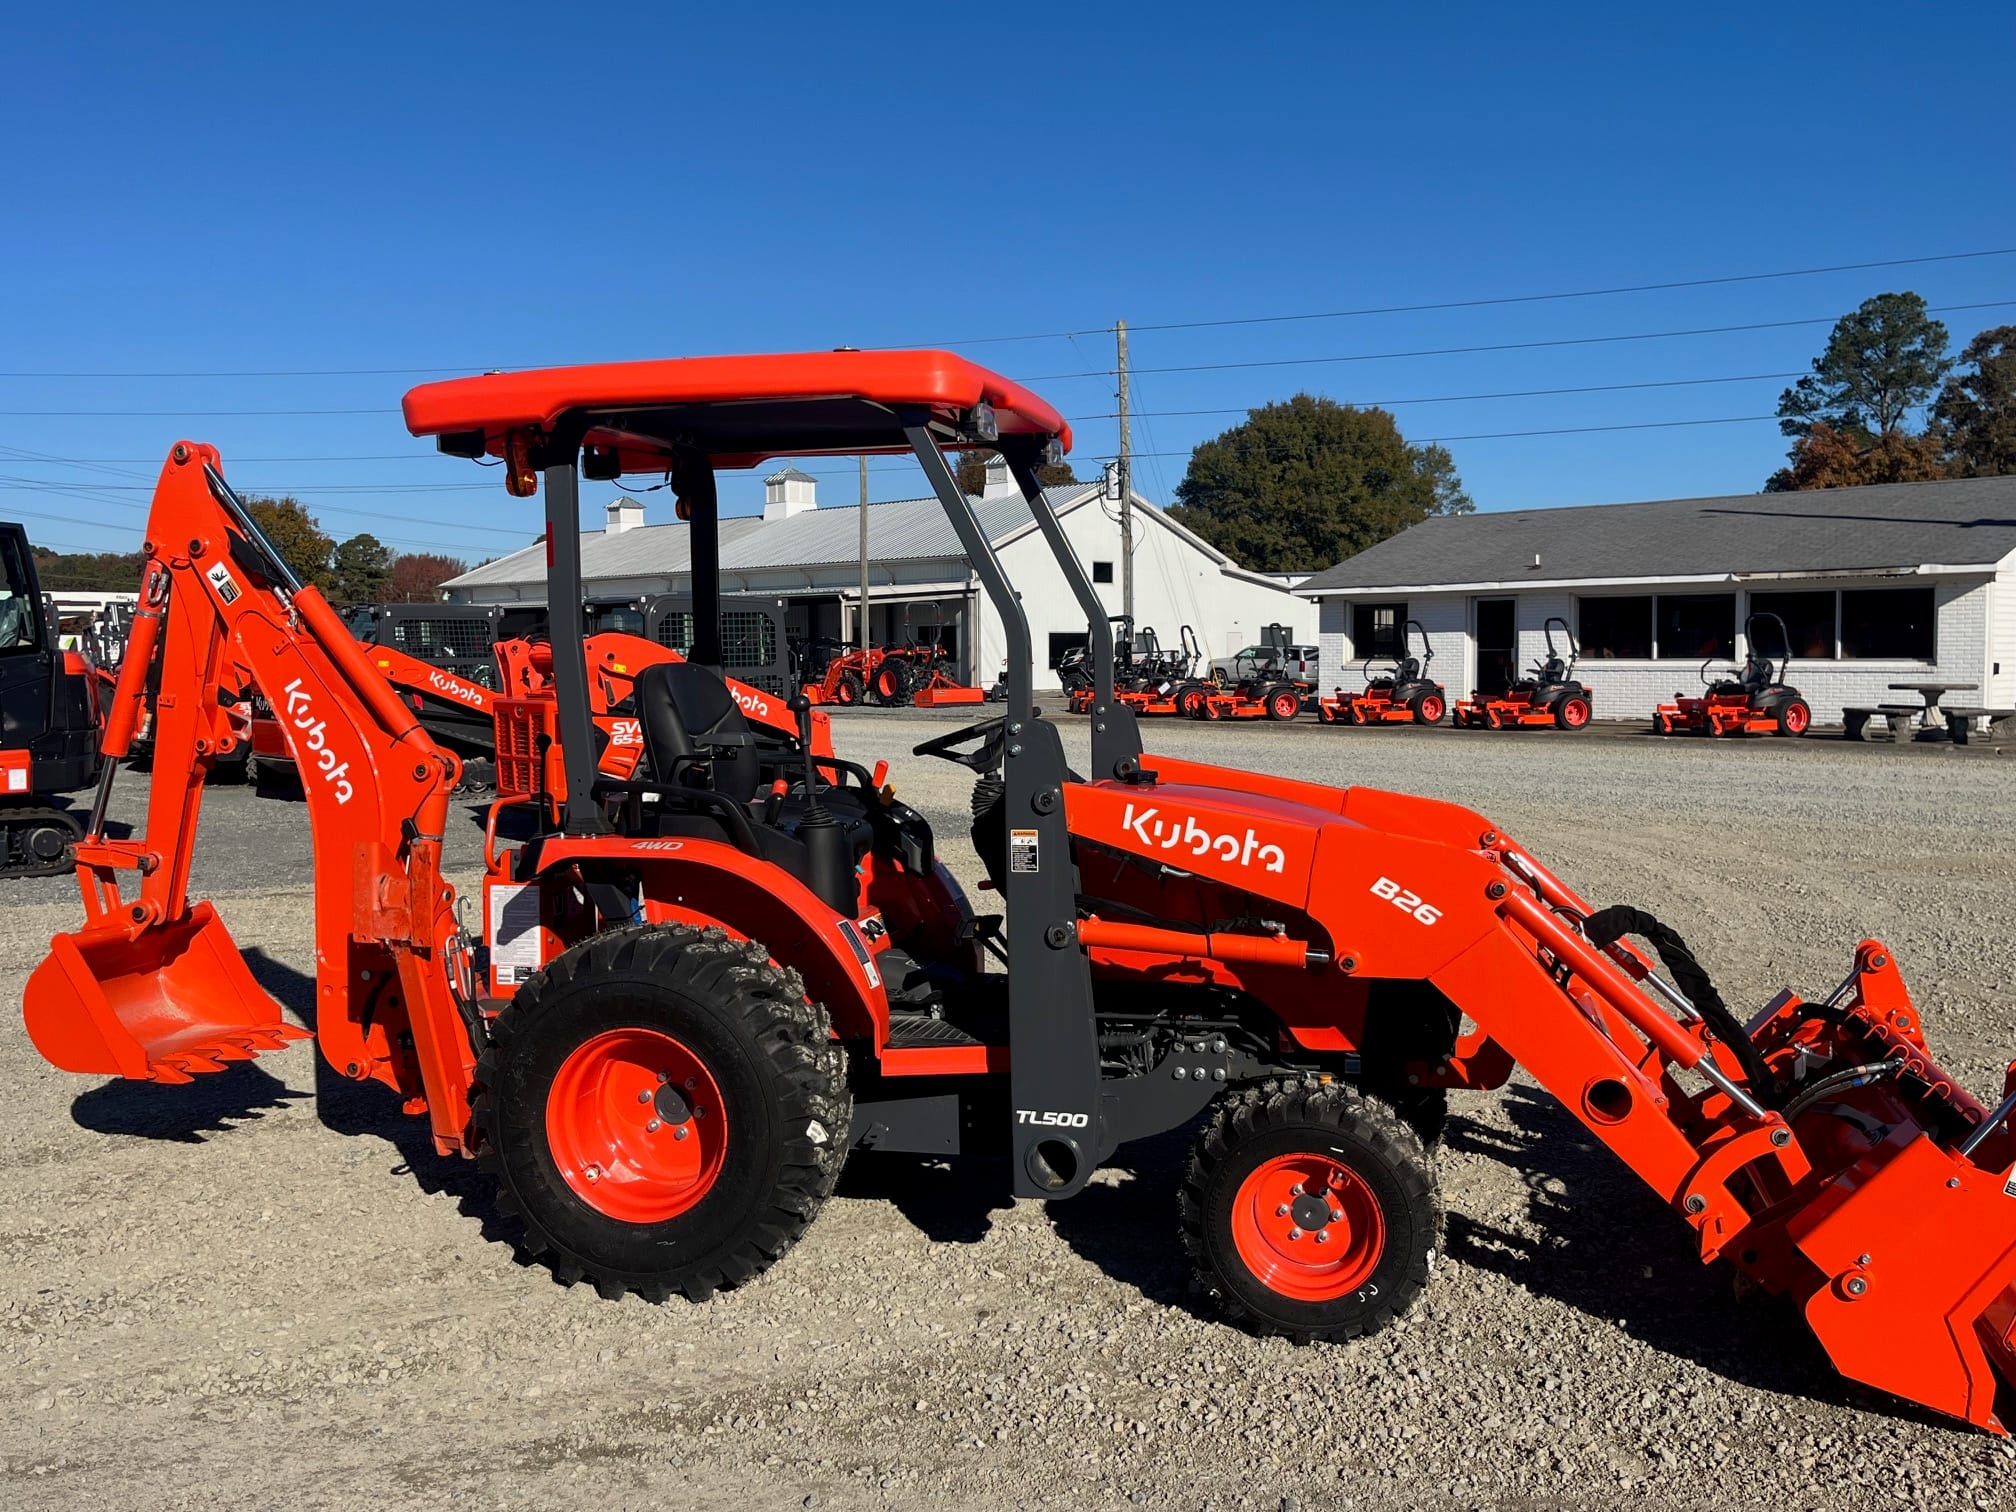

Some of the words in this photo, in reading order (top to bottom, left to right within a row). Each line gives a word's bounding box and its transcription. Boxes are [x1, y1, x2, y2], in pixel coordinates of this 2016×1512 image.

[430, 671, 483, 705] Kubota
[731, 686, 768, 717] bota
[284, 678, 353, 805] Kubota
[631, 841, 684, 850] 4WD
[1122, 803, 1285, 874] Kubota
[1369, 876, 1444, 926] B26
[1016, 1109, 1089, 1128] TL500
